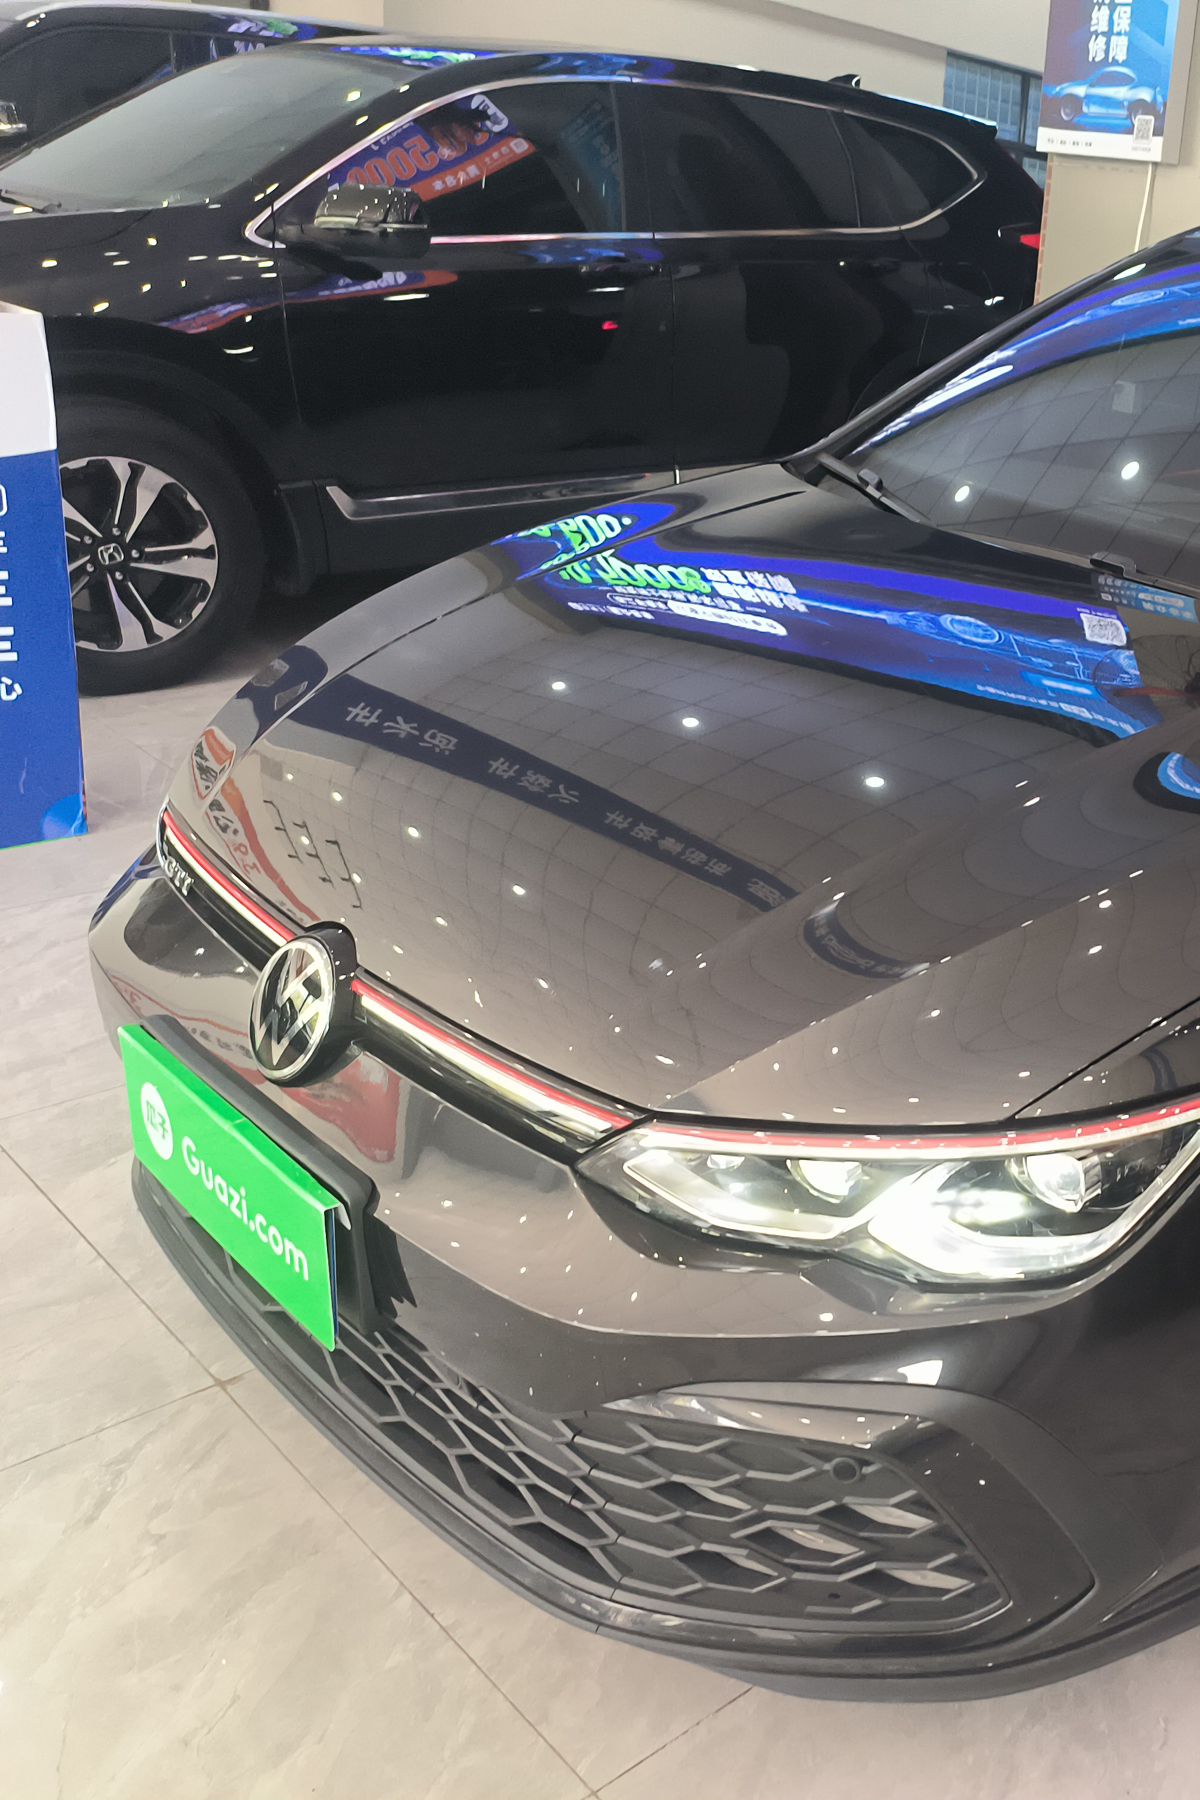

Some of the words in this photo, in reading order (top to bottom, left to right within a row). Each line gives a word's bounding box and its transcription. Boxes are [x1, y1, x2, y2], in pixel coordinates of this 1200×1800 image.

[1088, 0, 1110, 62] 维修
[1108, 0, 1133, 64] 保障
[164, 856, 195, 897] GTI
[181, 1135, 309, 1281] Guazi.com
